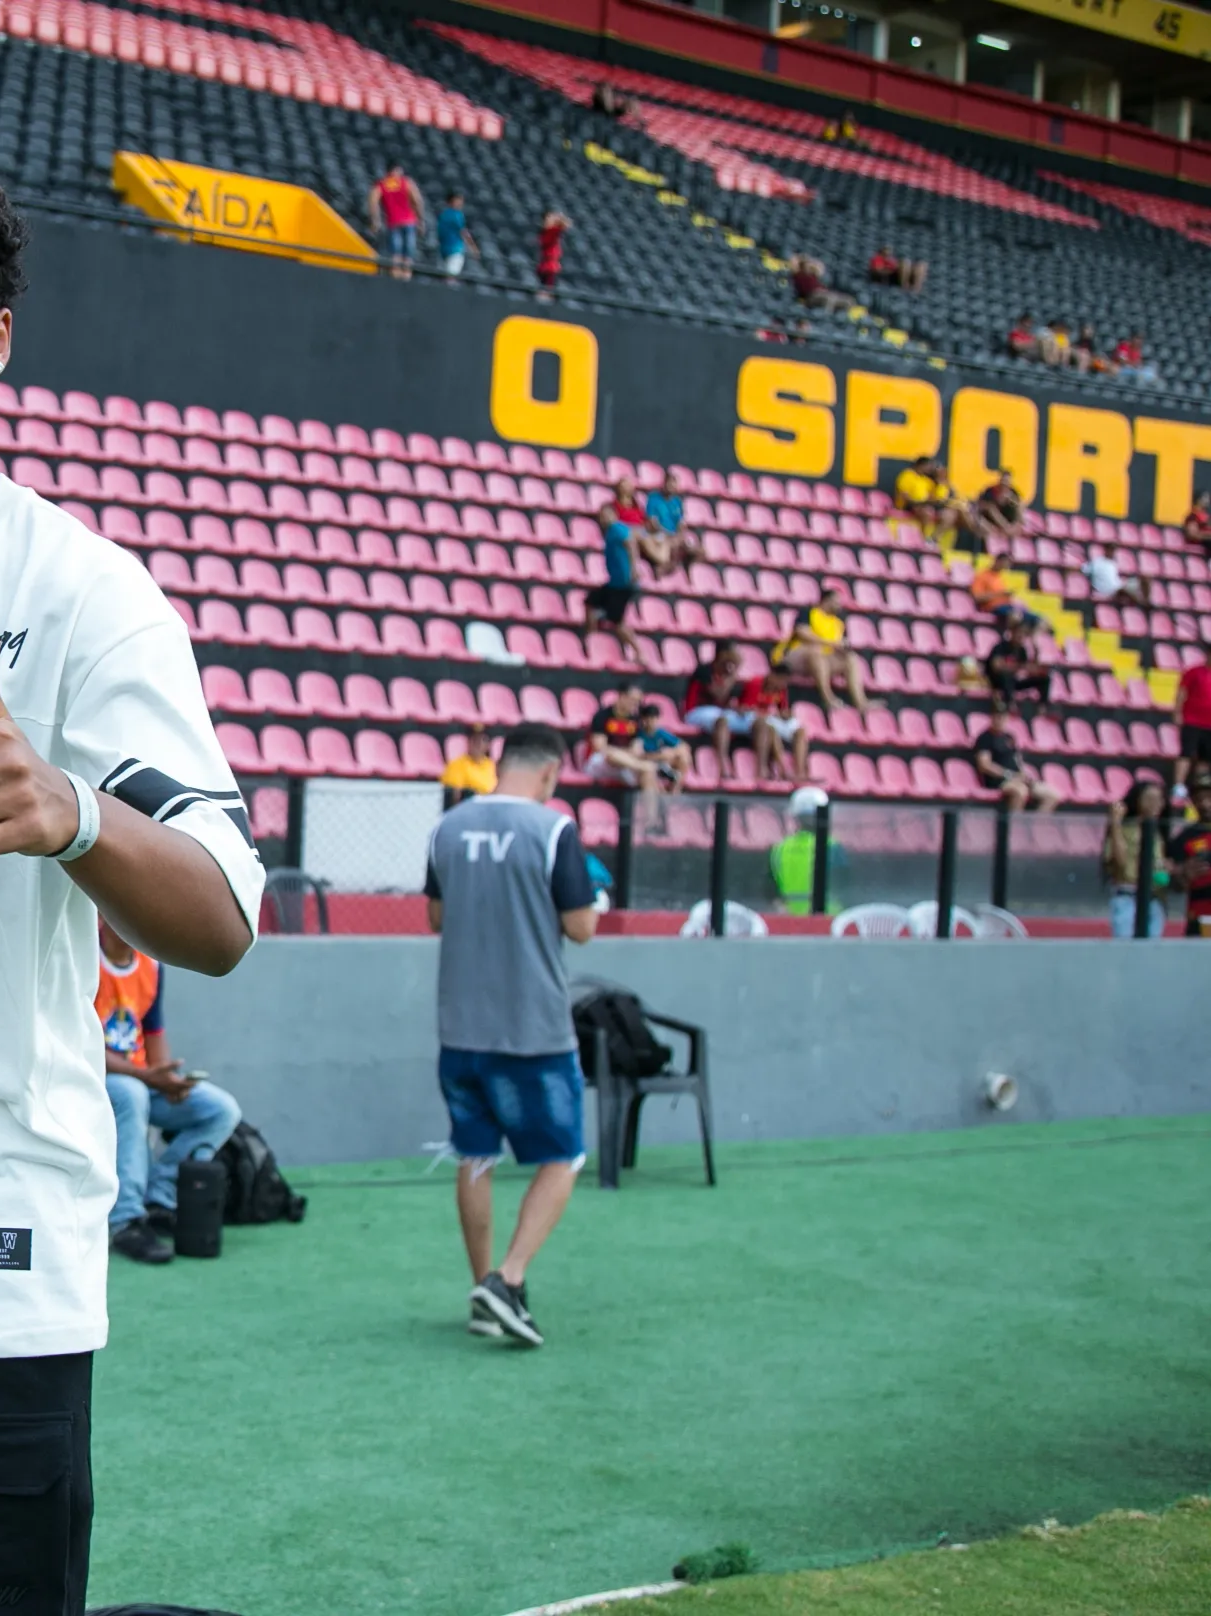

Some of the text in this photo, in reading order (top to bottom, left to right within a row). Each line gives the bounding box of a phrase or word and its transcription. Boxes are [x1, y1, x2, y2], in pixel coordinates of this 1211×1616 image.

[490, 315, 1211, 527] O SPORT
[461, 830, 516, 863] TV
